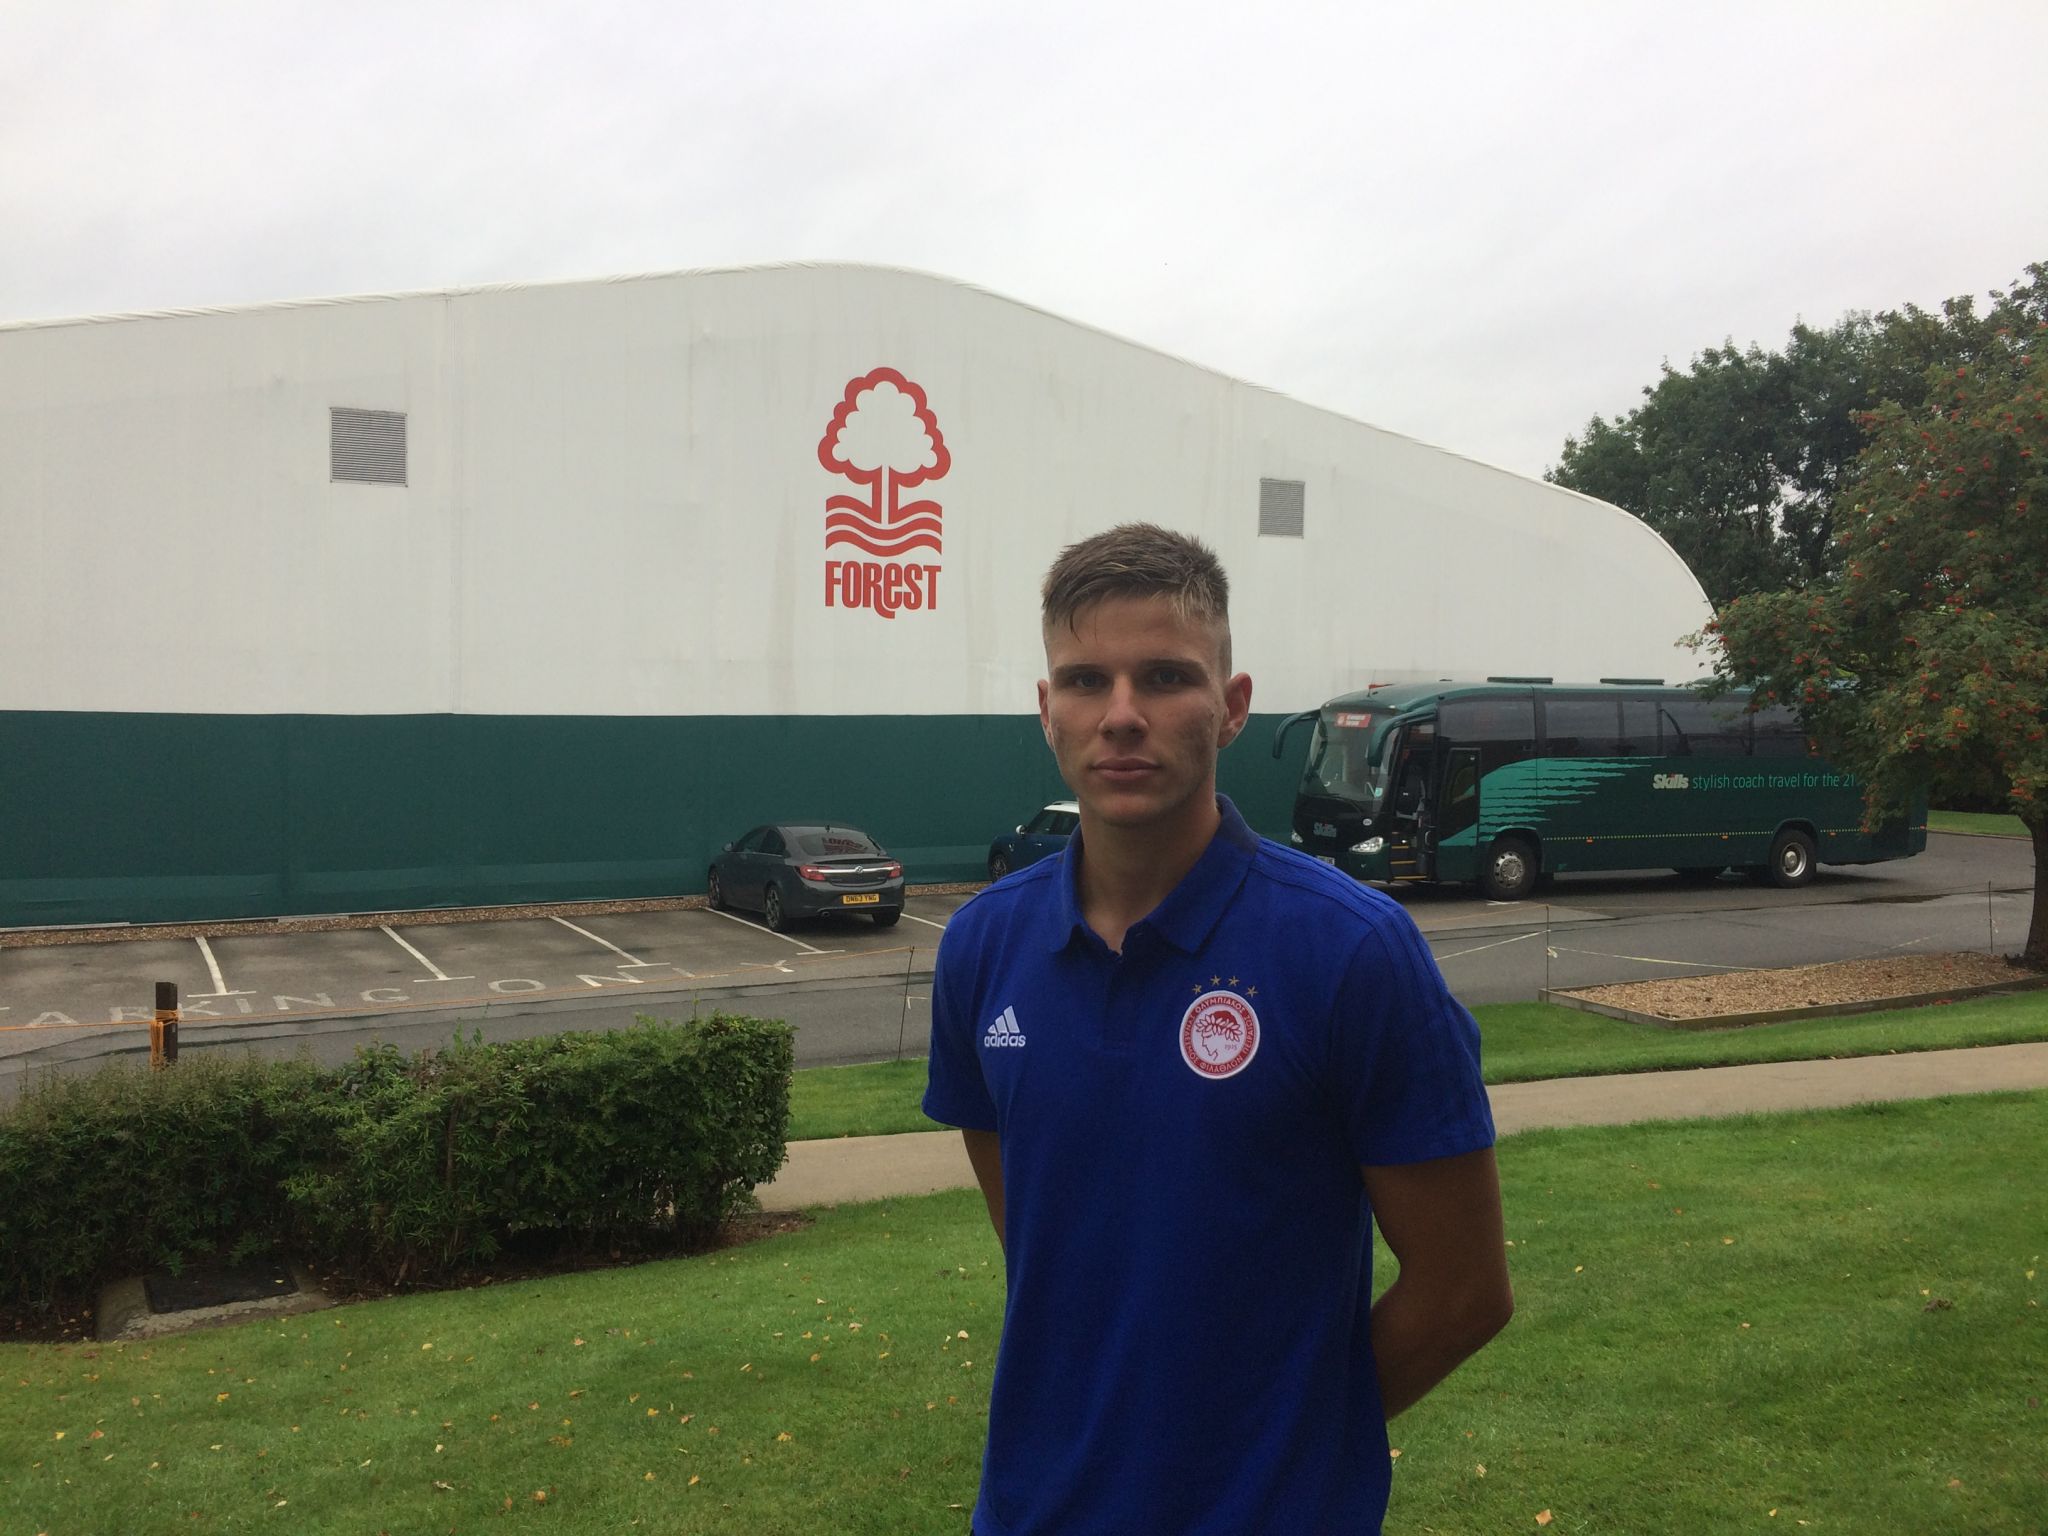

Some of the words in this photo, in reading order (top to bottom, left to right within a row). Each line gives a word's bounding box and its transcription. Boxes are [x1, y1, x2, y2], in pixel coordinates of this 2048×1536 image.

[1653, 774, 1689, 789] Skills
[1692, 774, 1730, 791] stylish
[1733, 774, 1764, 789] coach
[1768, 774, 1800, 788] travel
[1803, 773, 1818, 787] for
[1822, 773, 1840, 787] the
[487, 959, 795, 993] ONLY
[1195, 997, 1245, 1013] ΟΛΥΜΠΙΑΚΟΣ
[984, 1031, 1026, 1047] adidas
